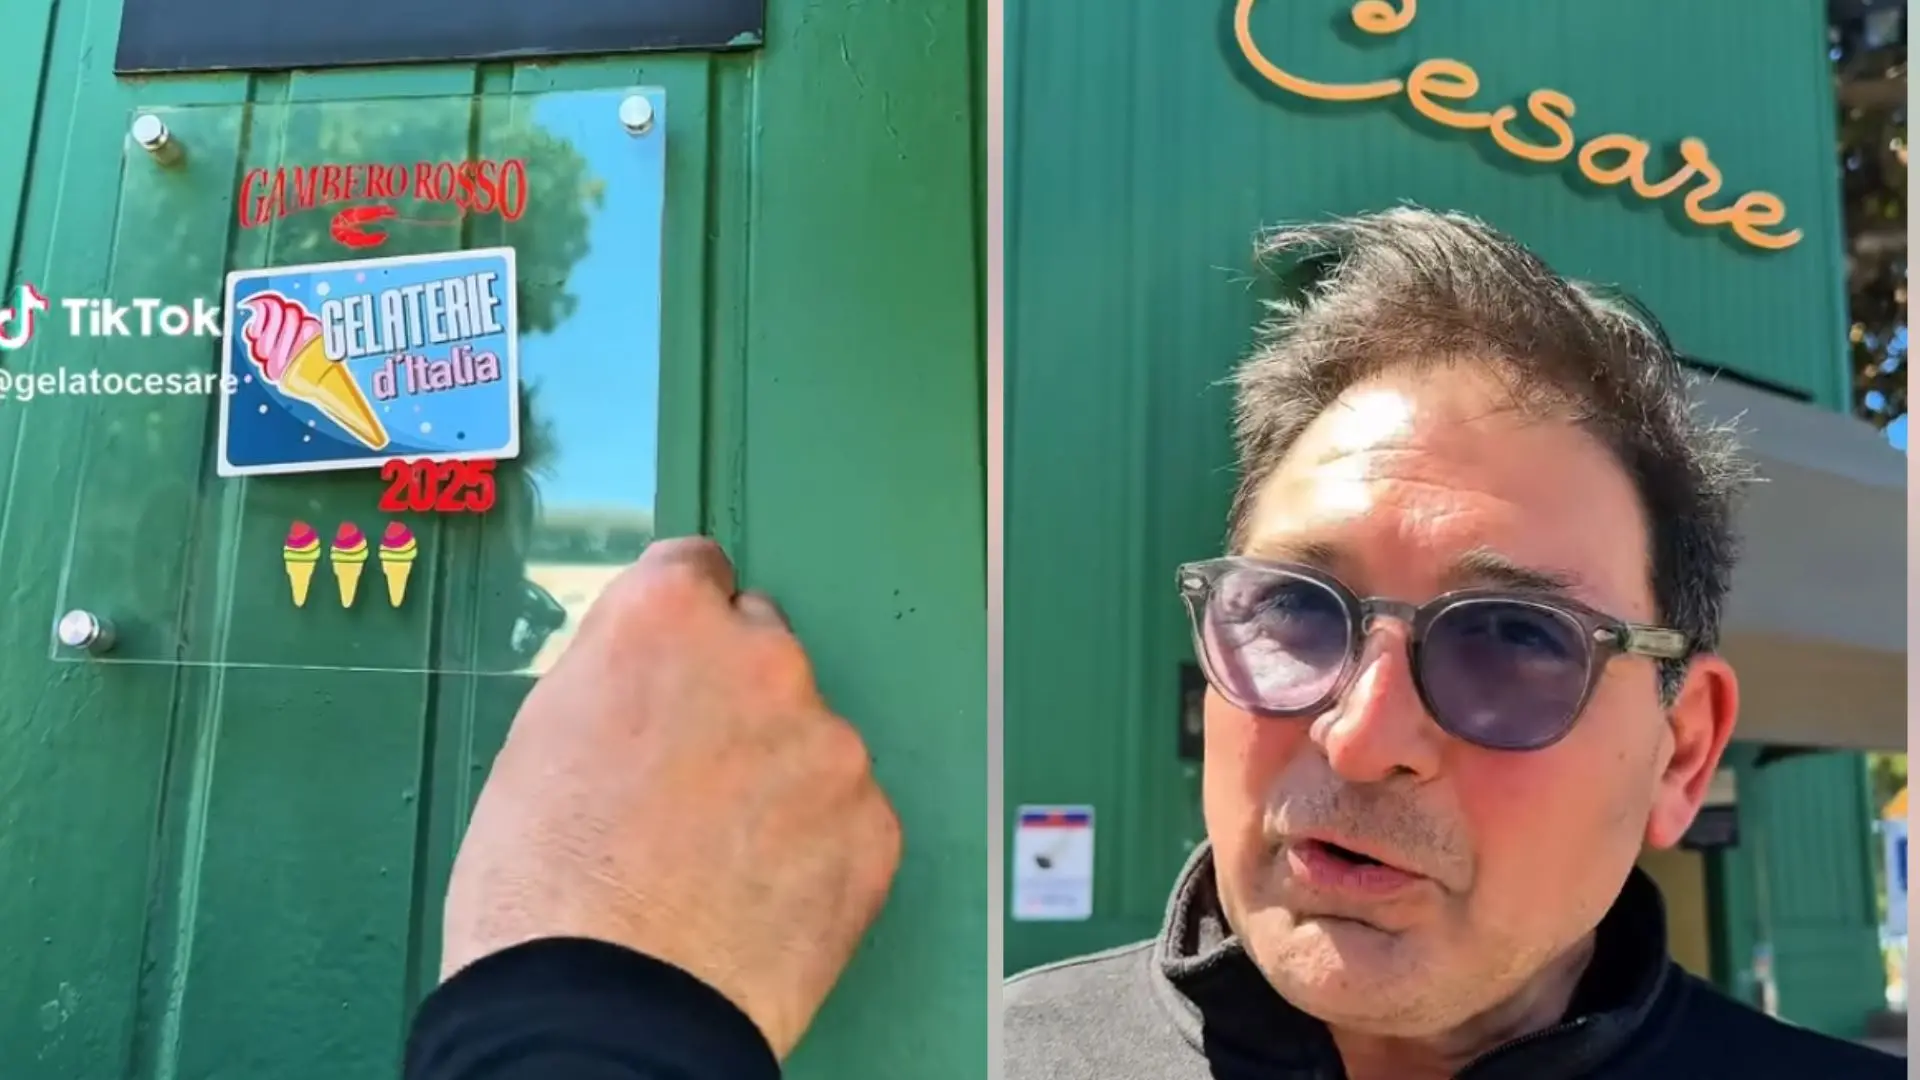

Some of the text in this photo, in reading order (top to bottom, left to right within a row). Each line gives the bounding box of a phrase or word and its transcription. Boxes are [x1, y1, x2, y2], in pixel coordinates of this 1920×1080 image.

[238, 158, 528, 229] GAMBERO ROSSO
[321, 271, 504, 363] GELATERIE
[378, 457, 496, 512] 2025
